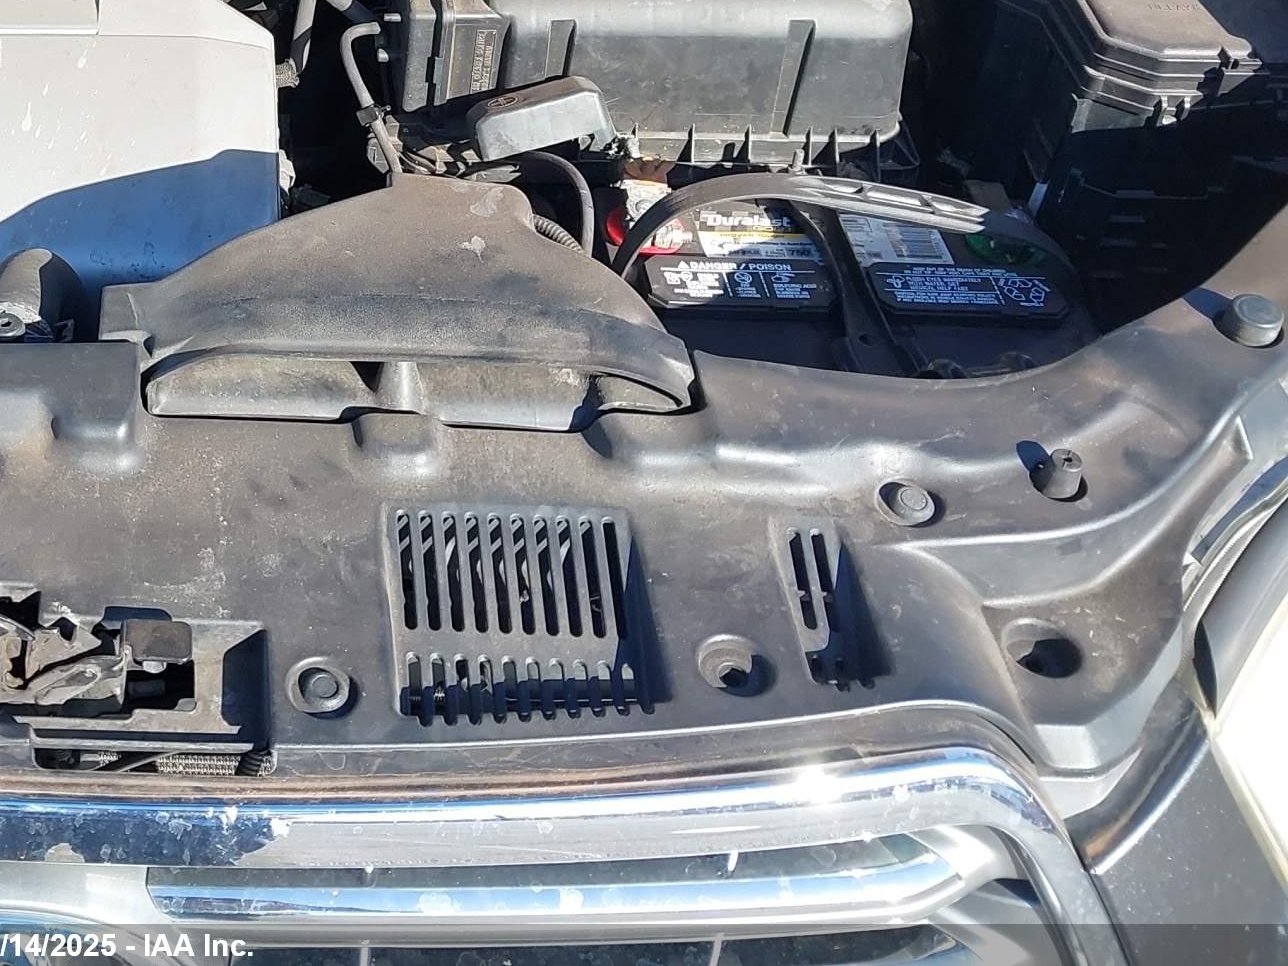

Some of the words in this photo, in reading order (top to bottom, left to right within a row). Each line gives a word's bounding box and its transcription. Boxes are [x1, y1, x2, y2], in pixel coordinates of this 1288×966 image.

[706, 213, 791, 227] Duralast
[690, 261, 737, 271] DANGER
[749, 263, 792, 271] POISON
